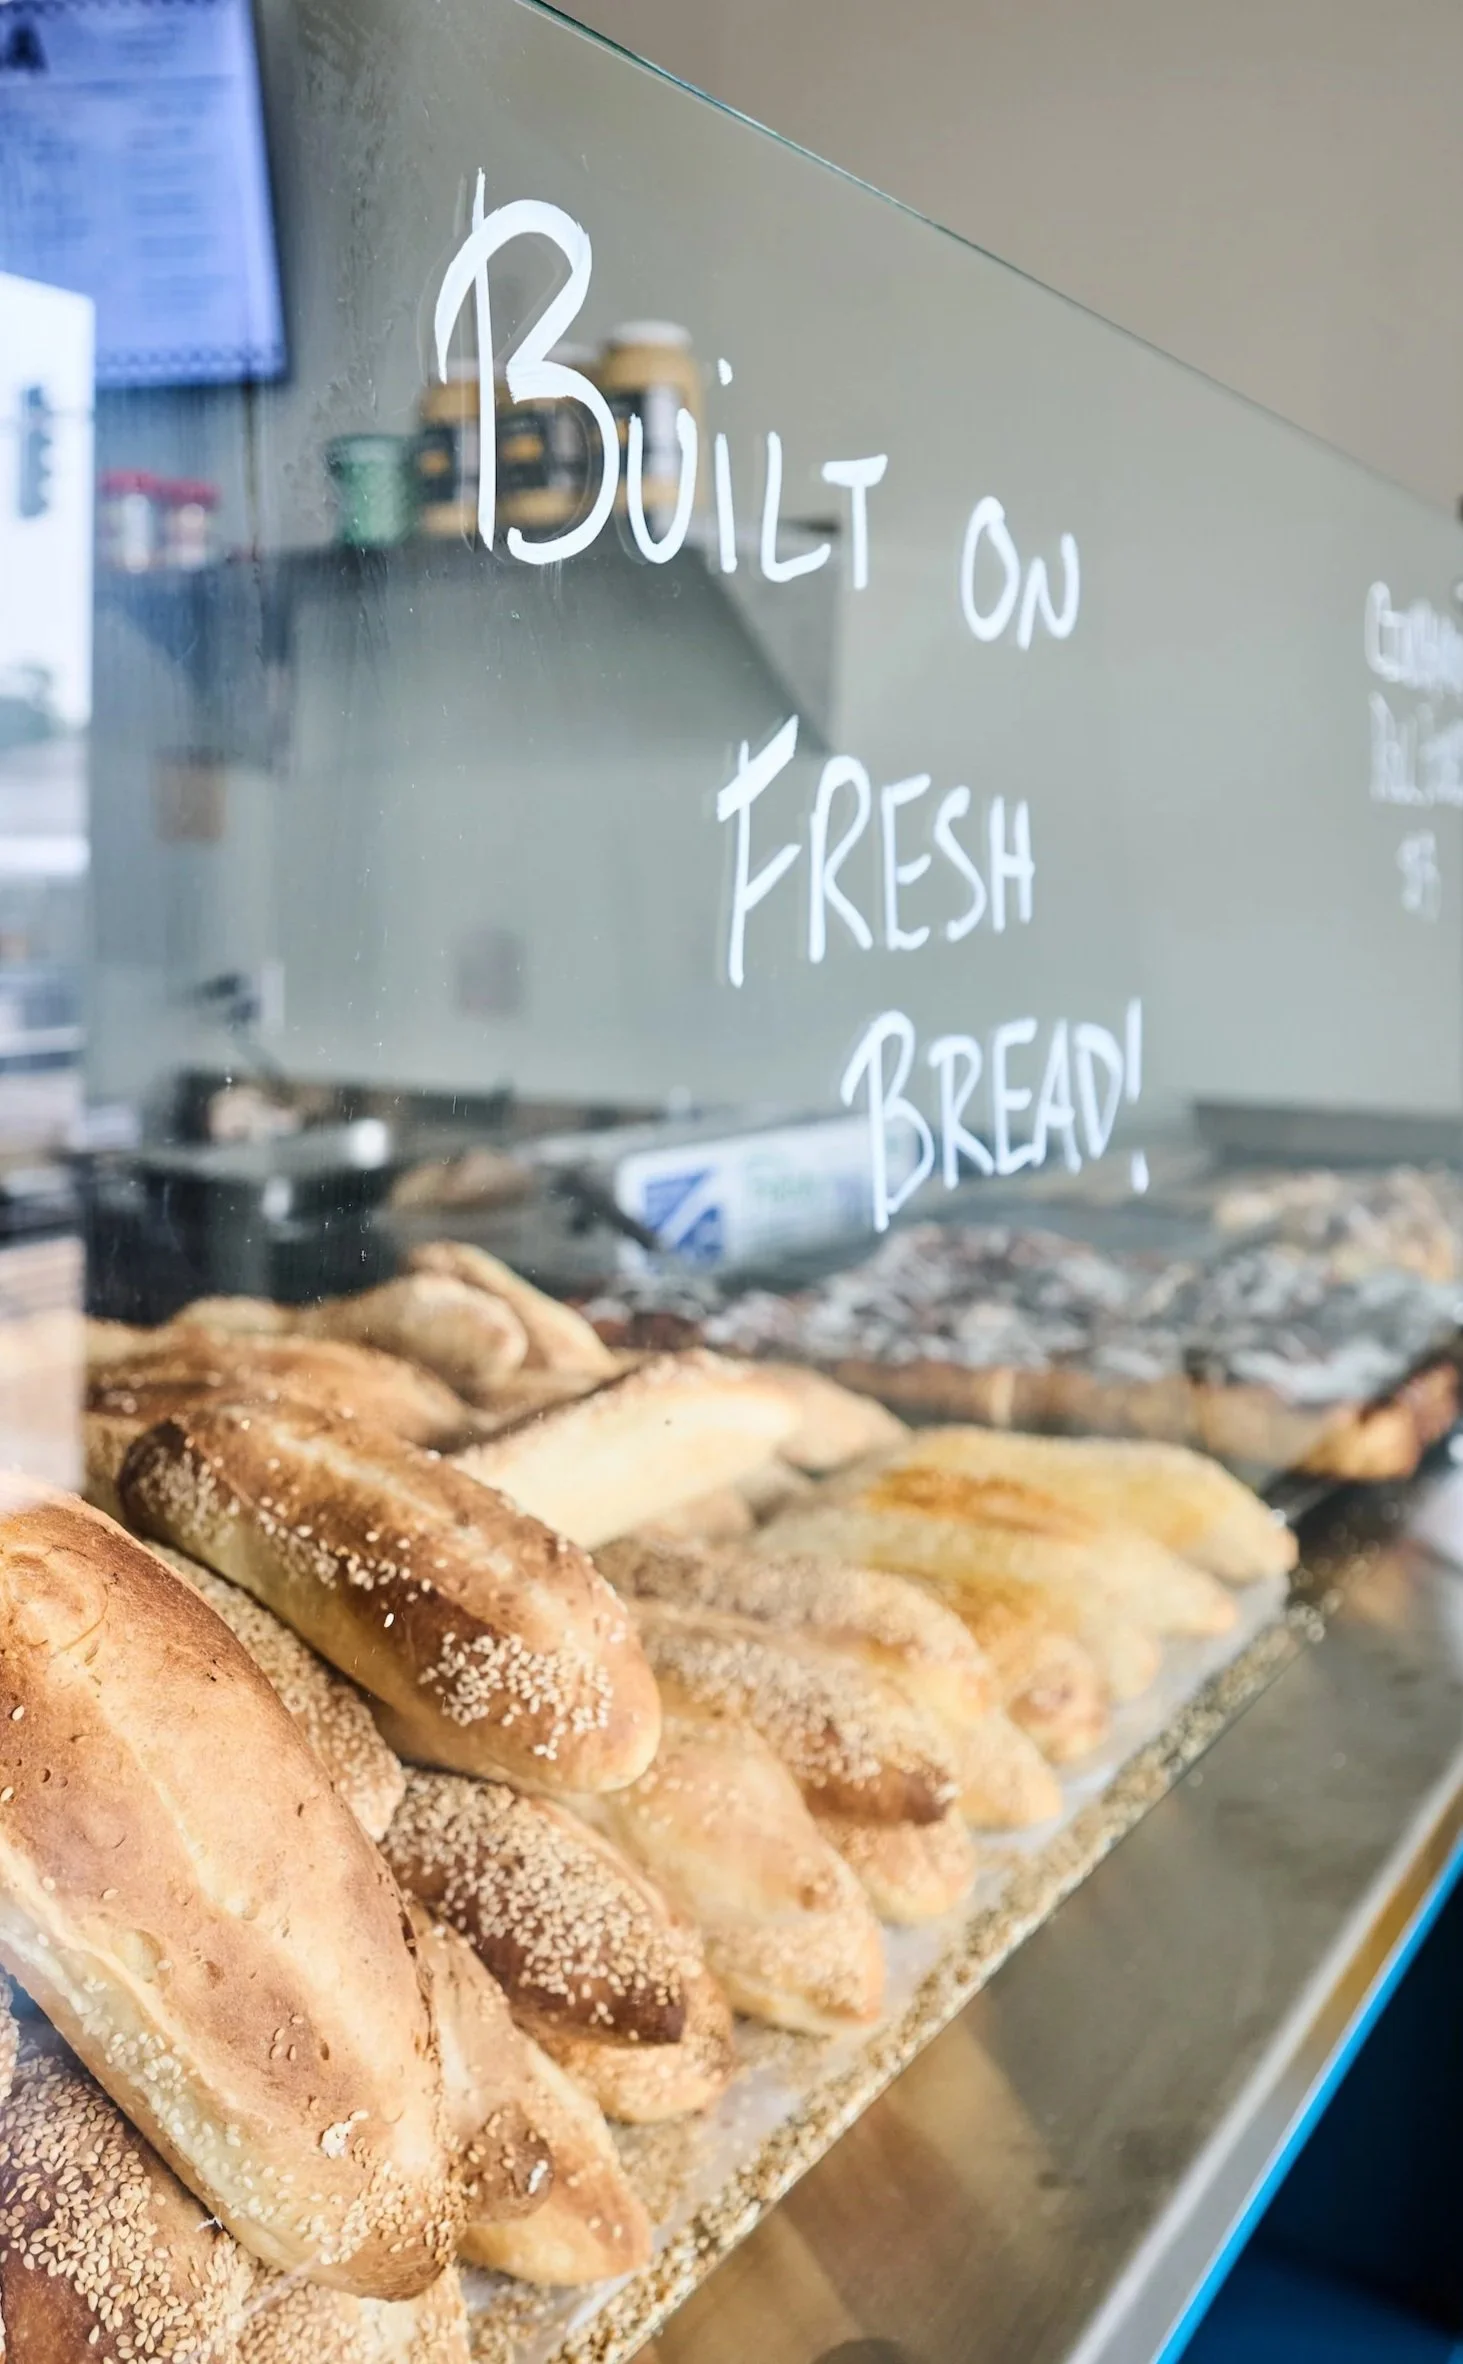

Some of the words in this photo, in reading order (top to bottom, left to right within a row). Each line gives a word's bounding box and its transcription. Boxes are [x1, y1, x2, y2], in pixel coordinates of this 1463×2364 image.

[961, 496, 1080, 650] ON
[717, 714, 1036, 988] FRESH
[840, 998, 1149, 1233] BREAD!
